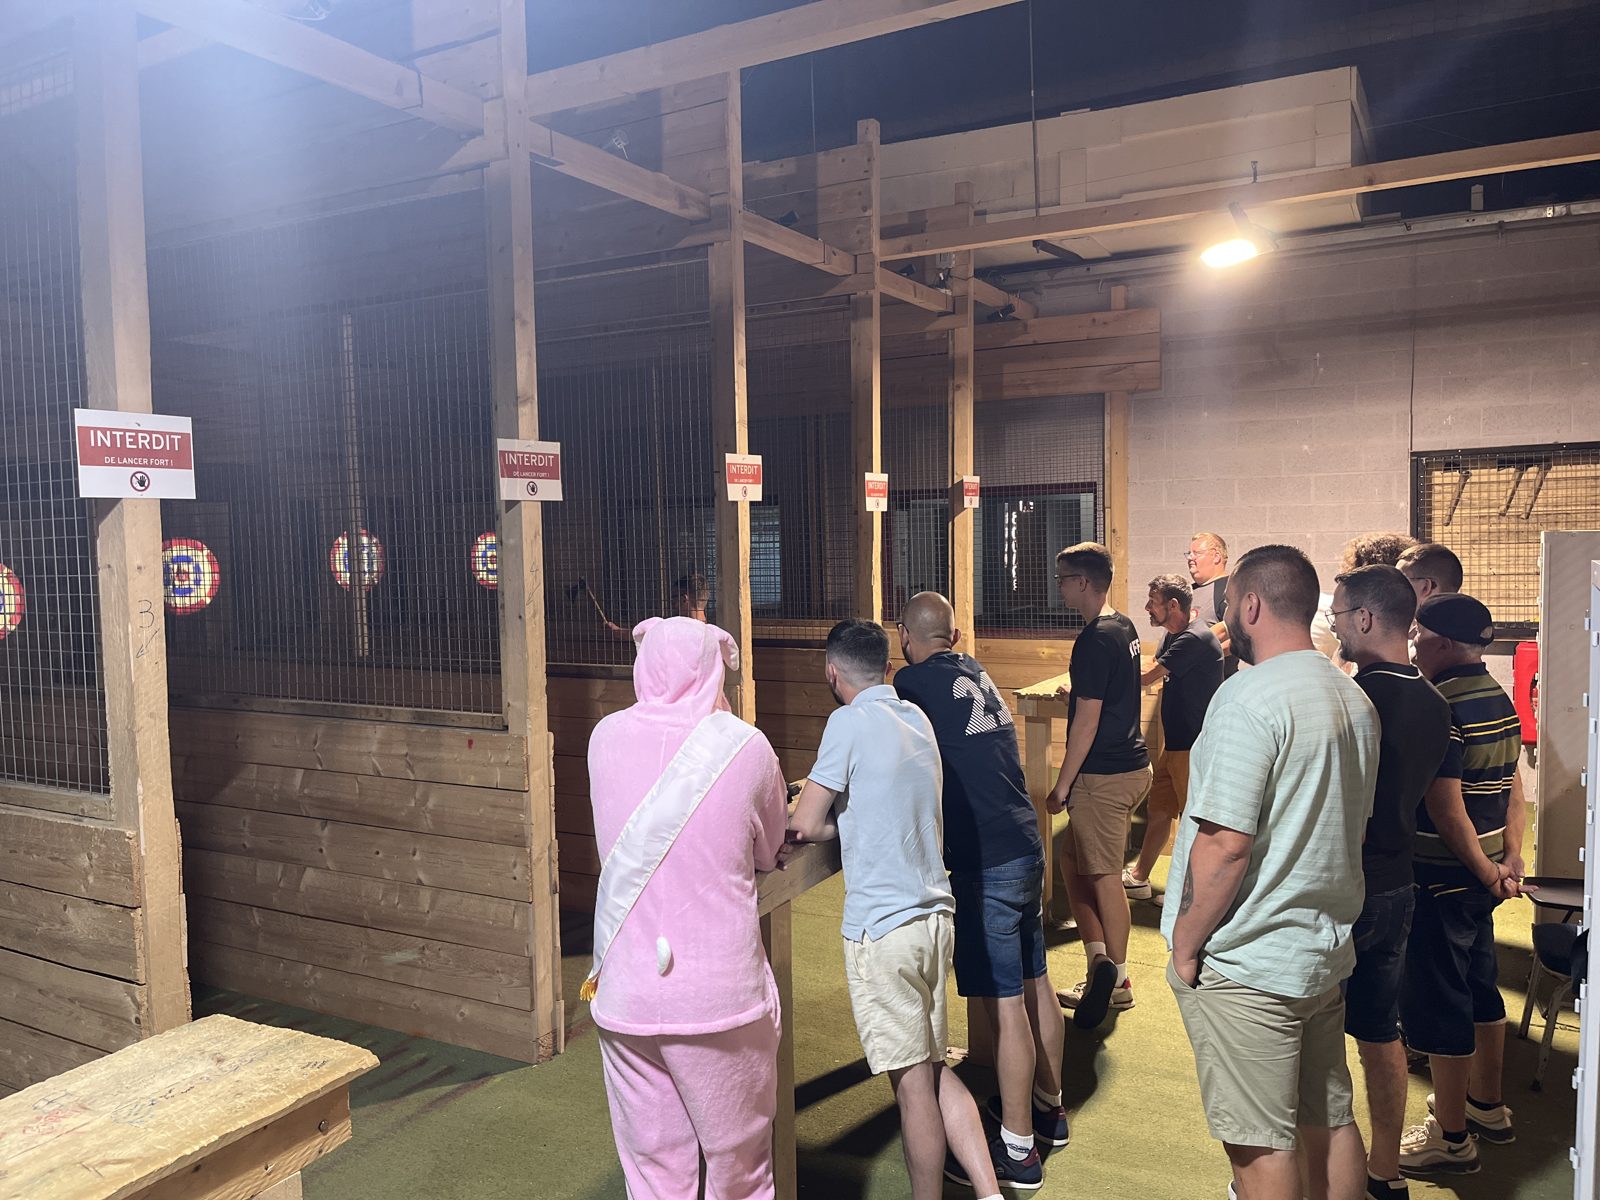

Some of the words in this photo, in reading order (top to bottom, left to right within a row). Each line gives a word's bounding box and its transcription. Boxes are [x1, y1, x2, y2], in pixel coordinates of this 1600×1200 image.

[90, 430, 181, 451] INTERDIT
[104, 456, 116, 464] DE
[117, 457, 148, 466] LANCER
[150, 458, 168, 466] FORT
[505, 453, 554, 467] INTERDIT
[730, 464, 759, 475] INTERDIT
[137, 599, 155, 628] 3
